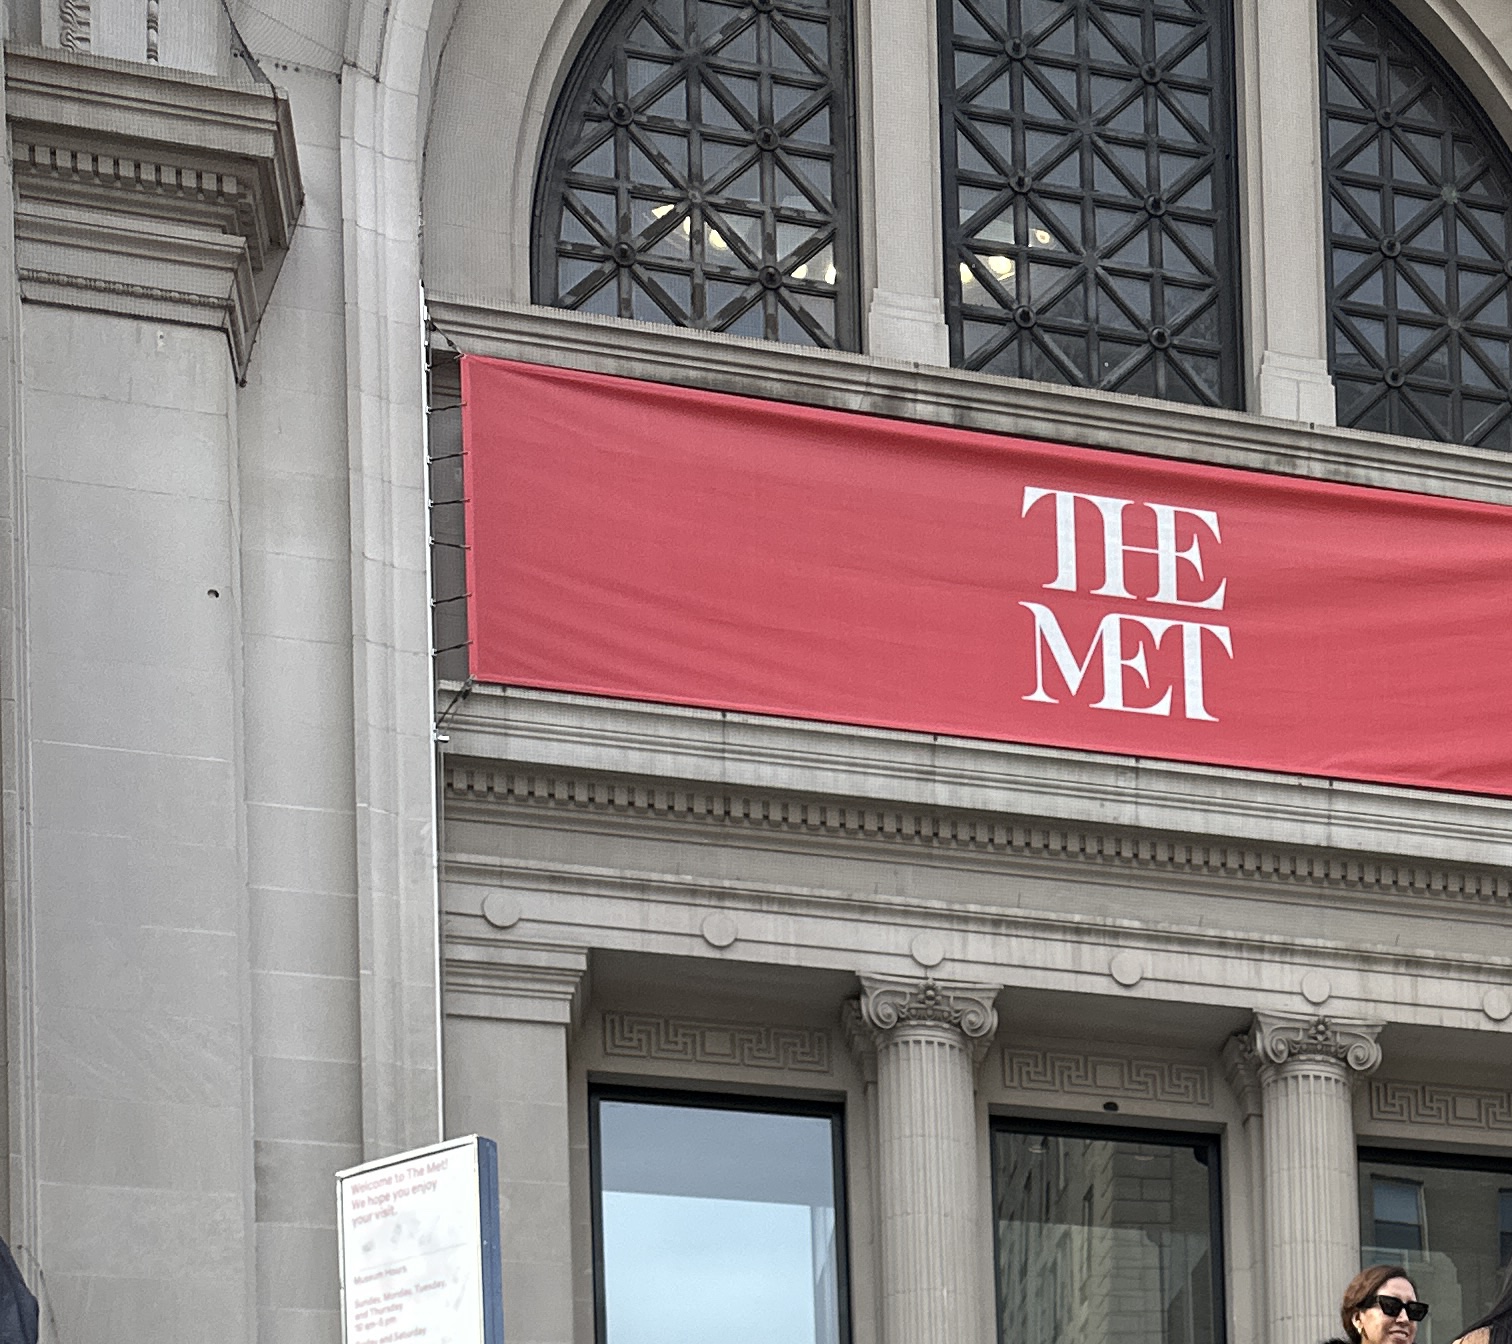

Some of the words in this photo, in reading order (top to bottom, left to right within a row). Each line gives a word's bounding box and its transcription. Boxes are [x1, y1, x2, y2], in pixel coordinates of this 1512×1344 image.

[1021, 486, 1227, 610] THE
[1017, 601, 1234, 722] MET
[367, 1192, 391, 1208] hope
[392, 1187, 410, 1202] you
[411, 1179, 438, 1195] enjoy
[407, 1166, 425, 1179] The
